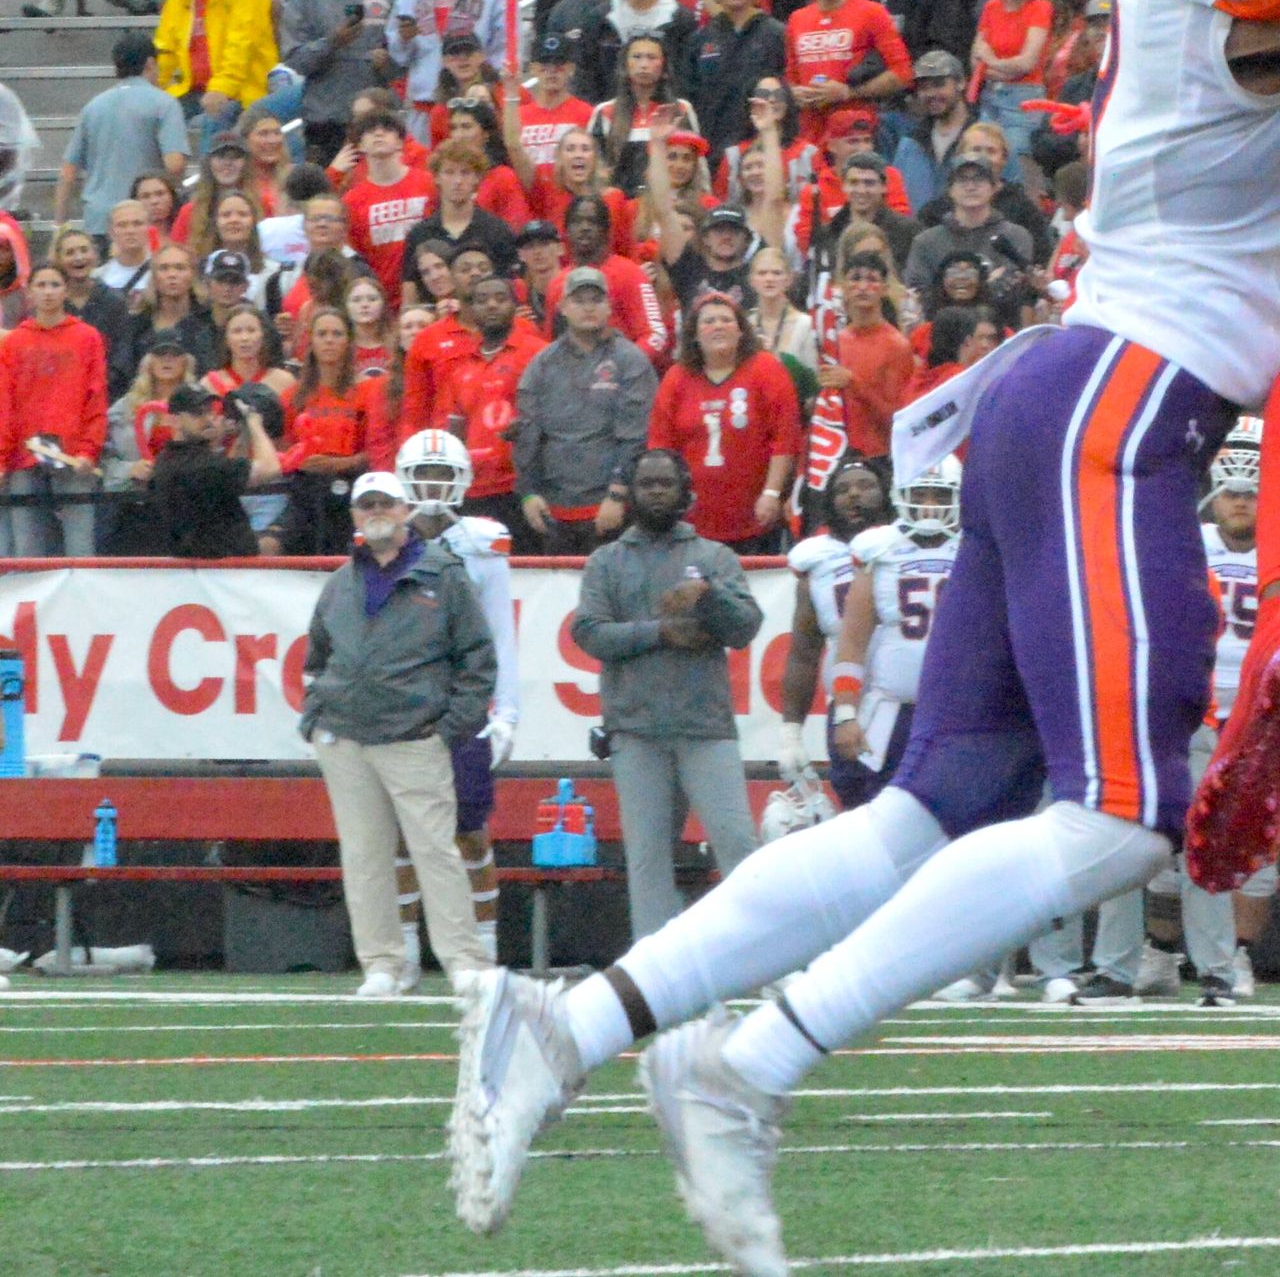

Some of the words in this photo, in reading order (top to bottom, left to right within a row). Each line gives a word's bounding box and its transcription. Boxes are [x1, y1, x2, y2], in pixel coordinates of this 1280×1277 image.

[797, 28, 854, 53] SEMO
[703, 411, 725, 466] 1
[897, 577, 950, 641] 5
